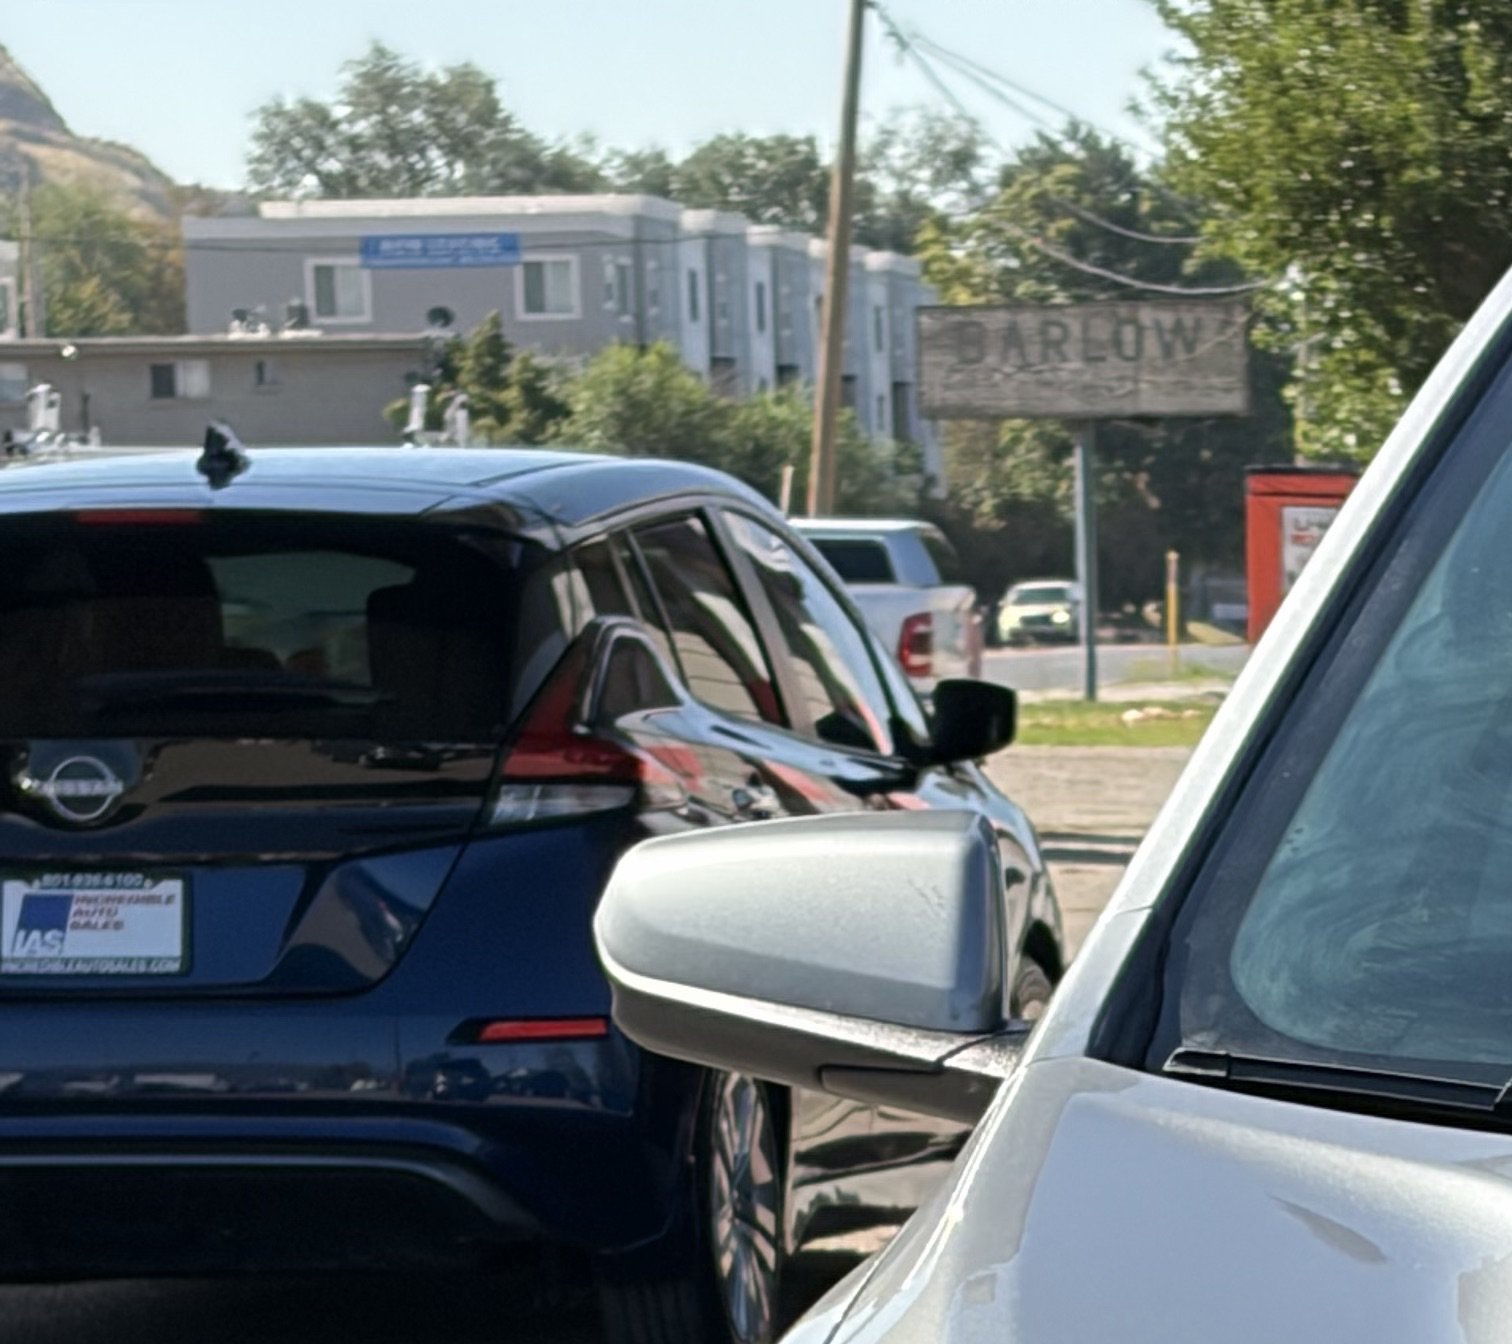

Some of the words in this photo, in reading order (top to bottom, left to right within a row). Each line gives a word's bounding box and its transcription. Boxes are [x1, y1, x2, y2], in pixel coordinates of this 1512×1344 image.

[955, 316, 1202, 366] BARLOW
[74, 893, 176, 906] INCREDIBLE
[72, 906, 119, 918] AUTO
[69, 919, 125, 931] SALES
[14, 928, 65, 955] IAS
